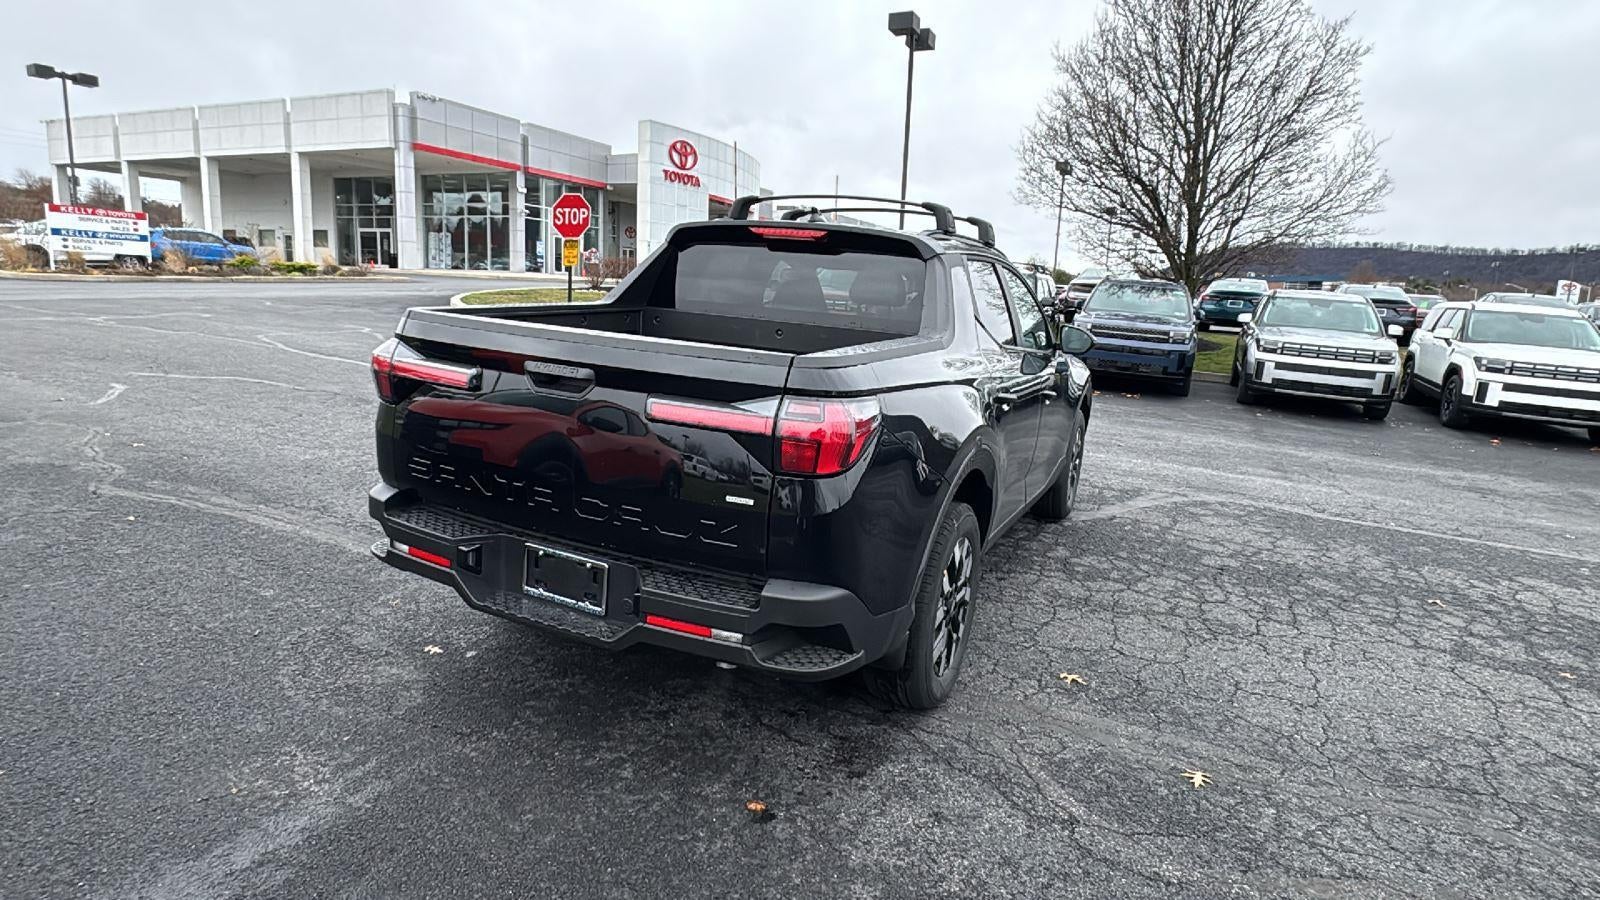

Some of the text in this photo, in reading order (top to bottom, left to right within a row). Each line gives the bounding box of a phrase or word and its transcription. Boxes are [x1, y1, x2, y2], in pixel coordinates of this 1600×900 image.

[662, 169, 701, 188] TOYOTA
[60, 205, 136, 219] KELLY TOYOTA
[554, 207, 589, 226] STOP
[61, 229, 93, 238] KELLY
